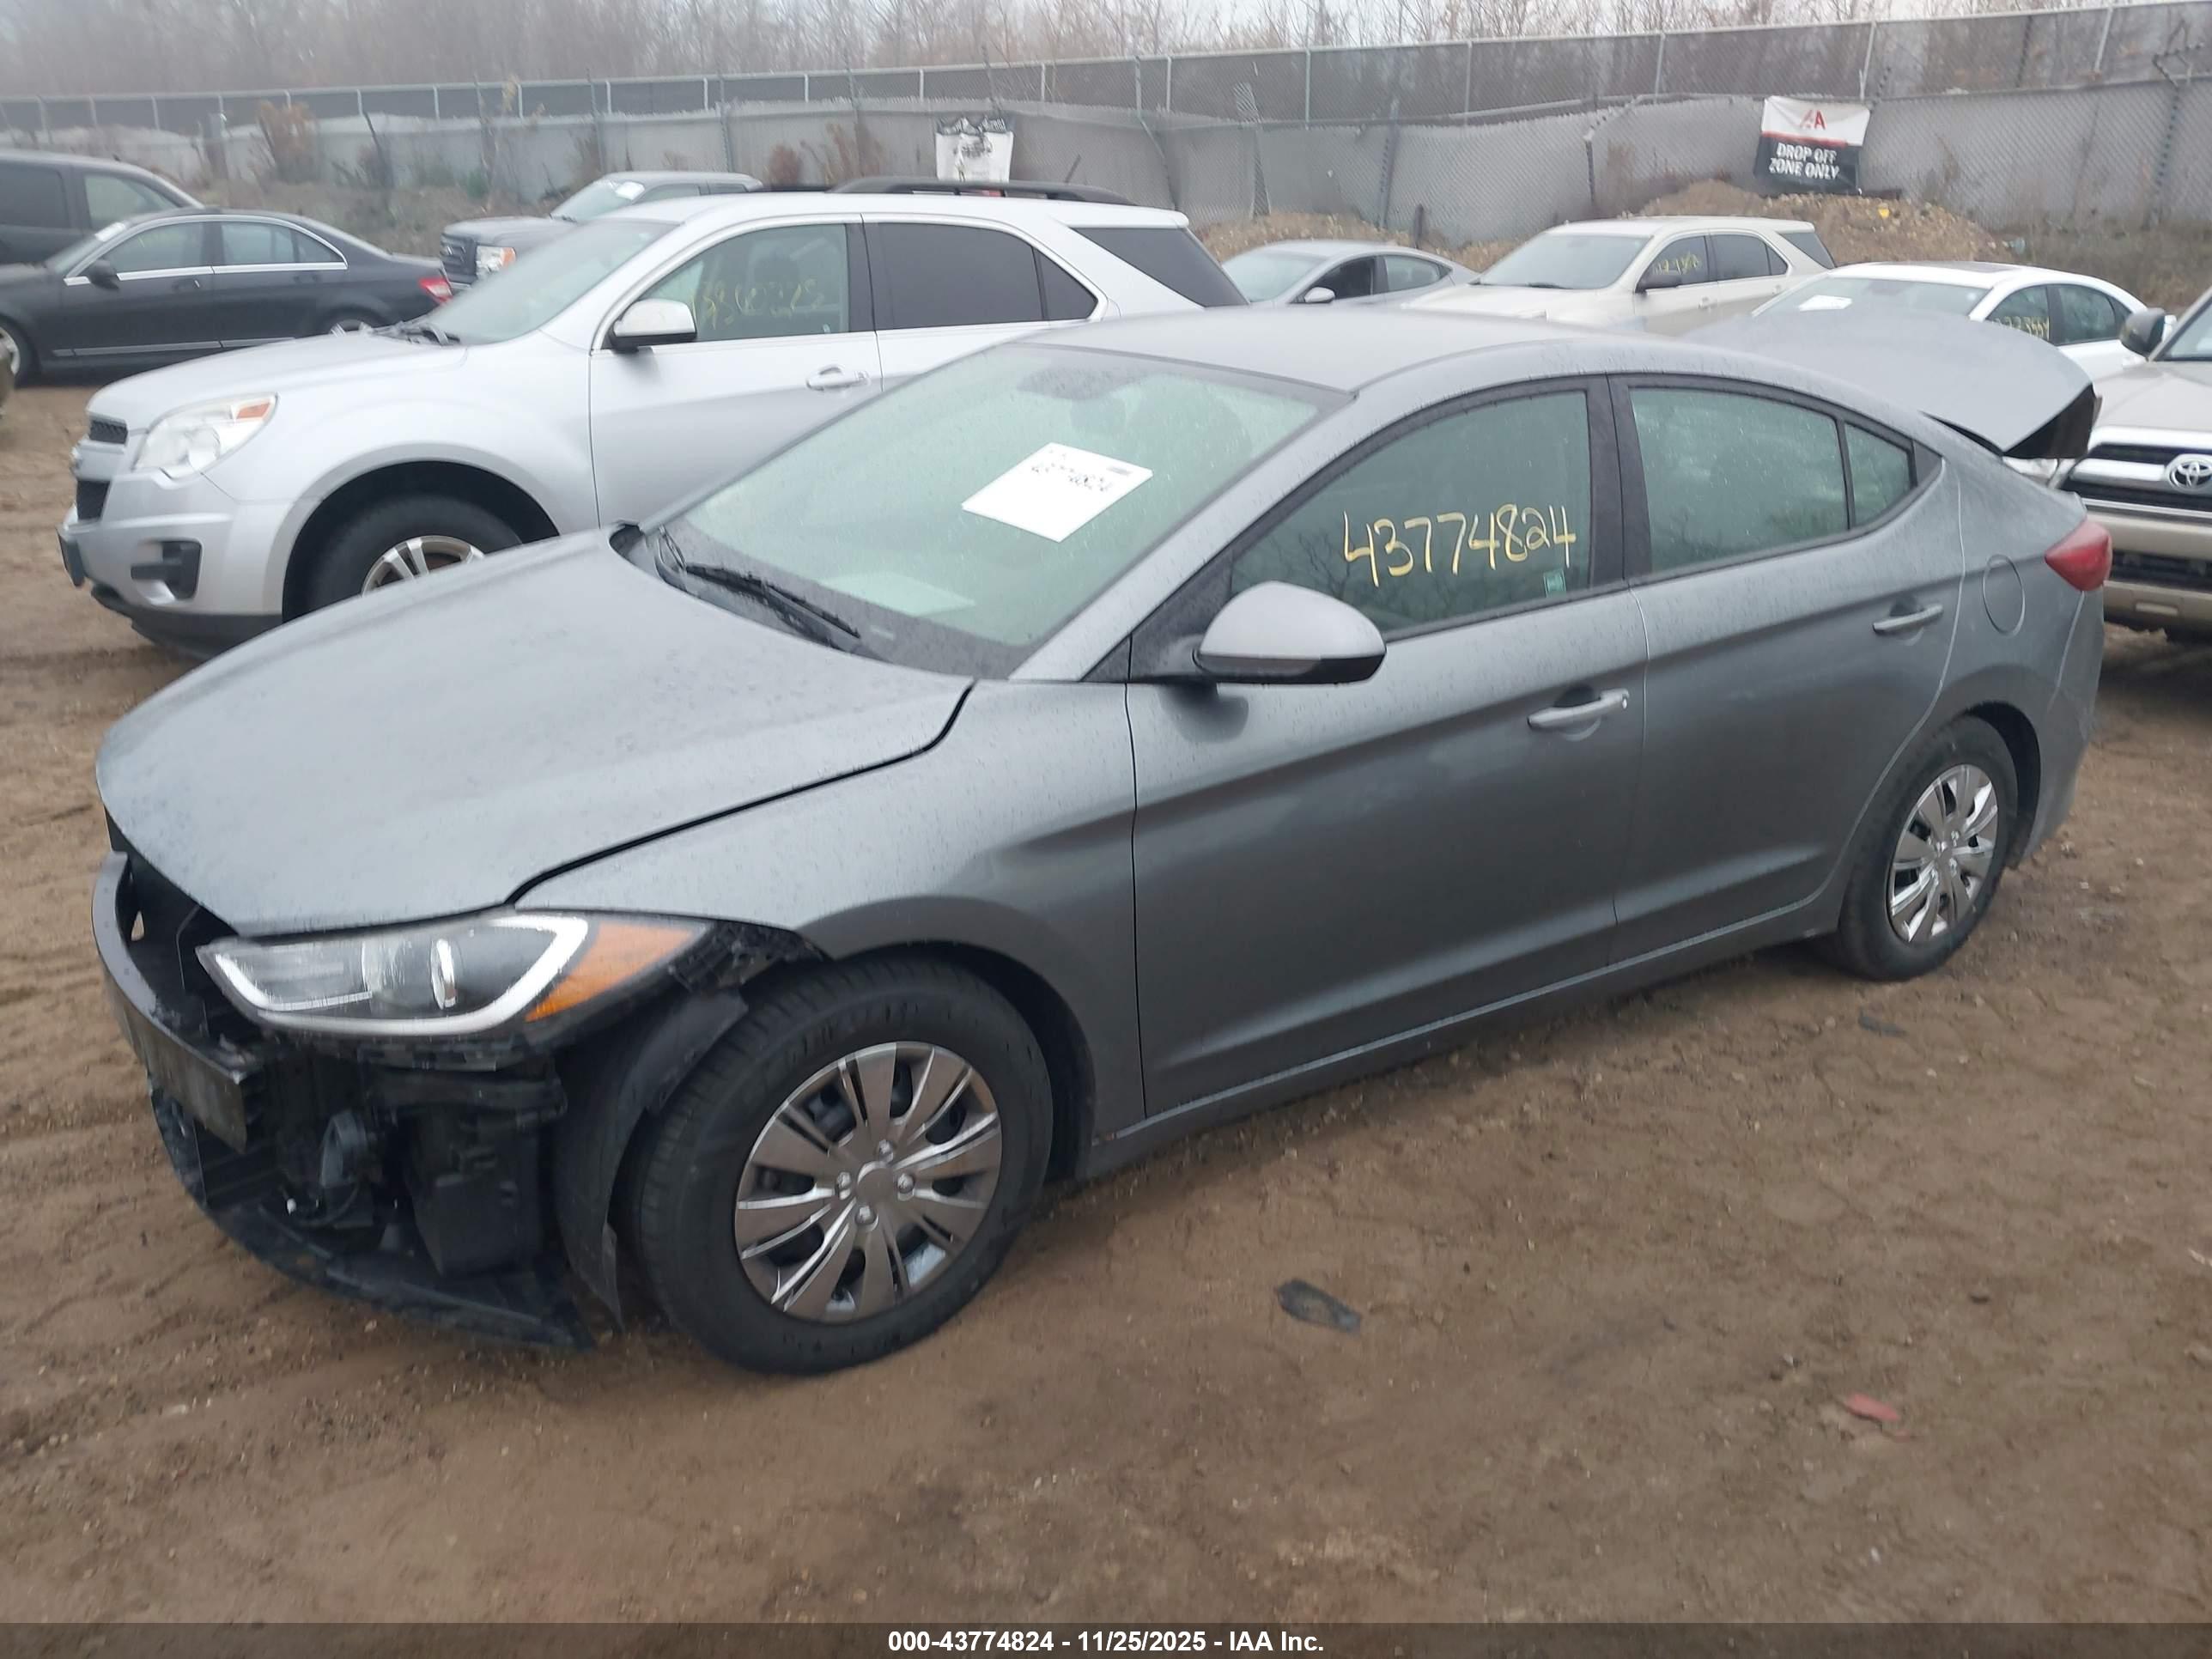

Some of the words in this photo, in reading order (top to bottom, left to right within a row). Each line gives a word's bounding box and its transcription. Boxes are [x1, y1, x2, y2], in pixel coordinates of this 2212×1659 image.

[1776, 143, 1812, 161] DROP
[1814, 149, 1837, 165] OFF
[1768, 157, 1802, 177] ZONE
[1804, 162, 1839, 180] ONLY
[1343, 503, 1577, 587] 43774824
